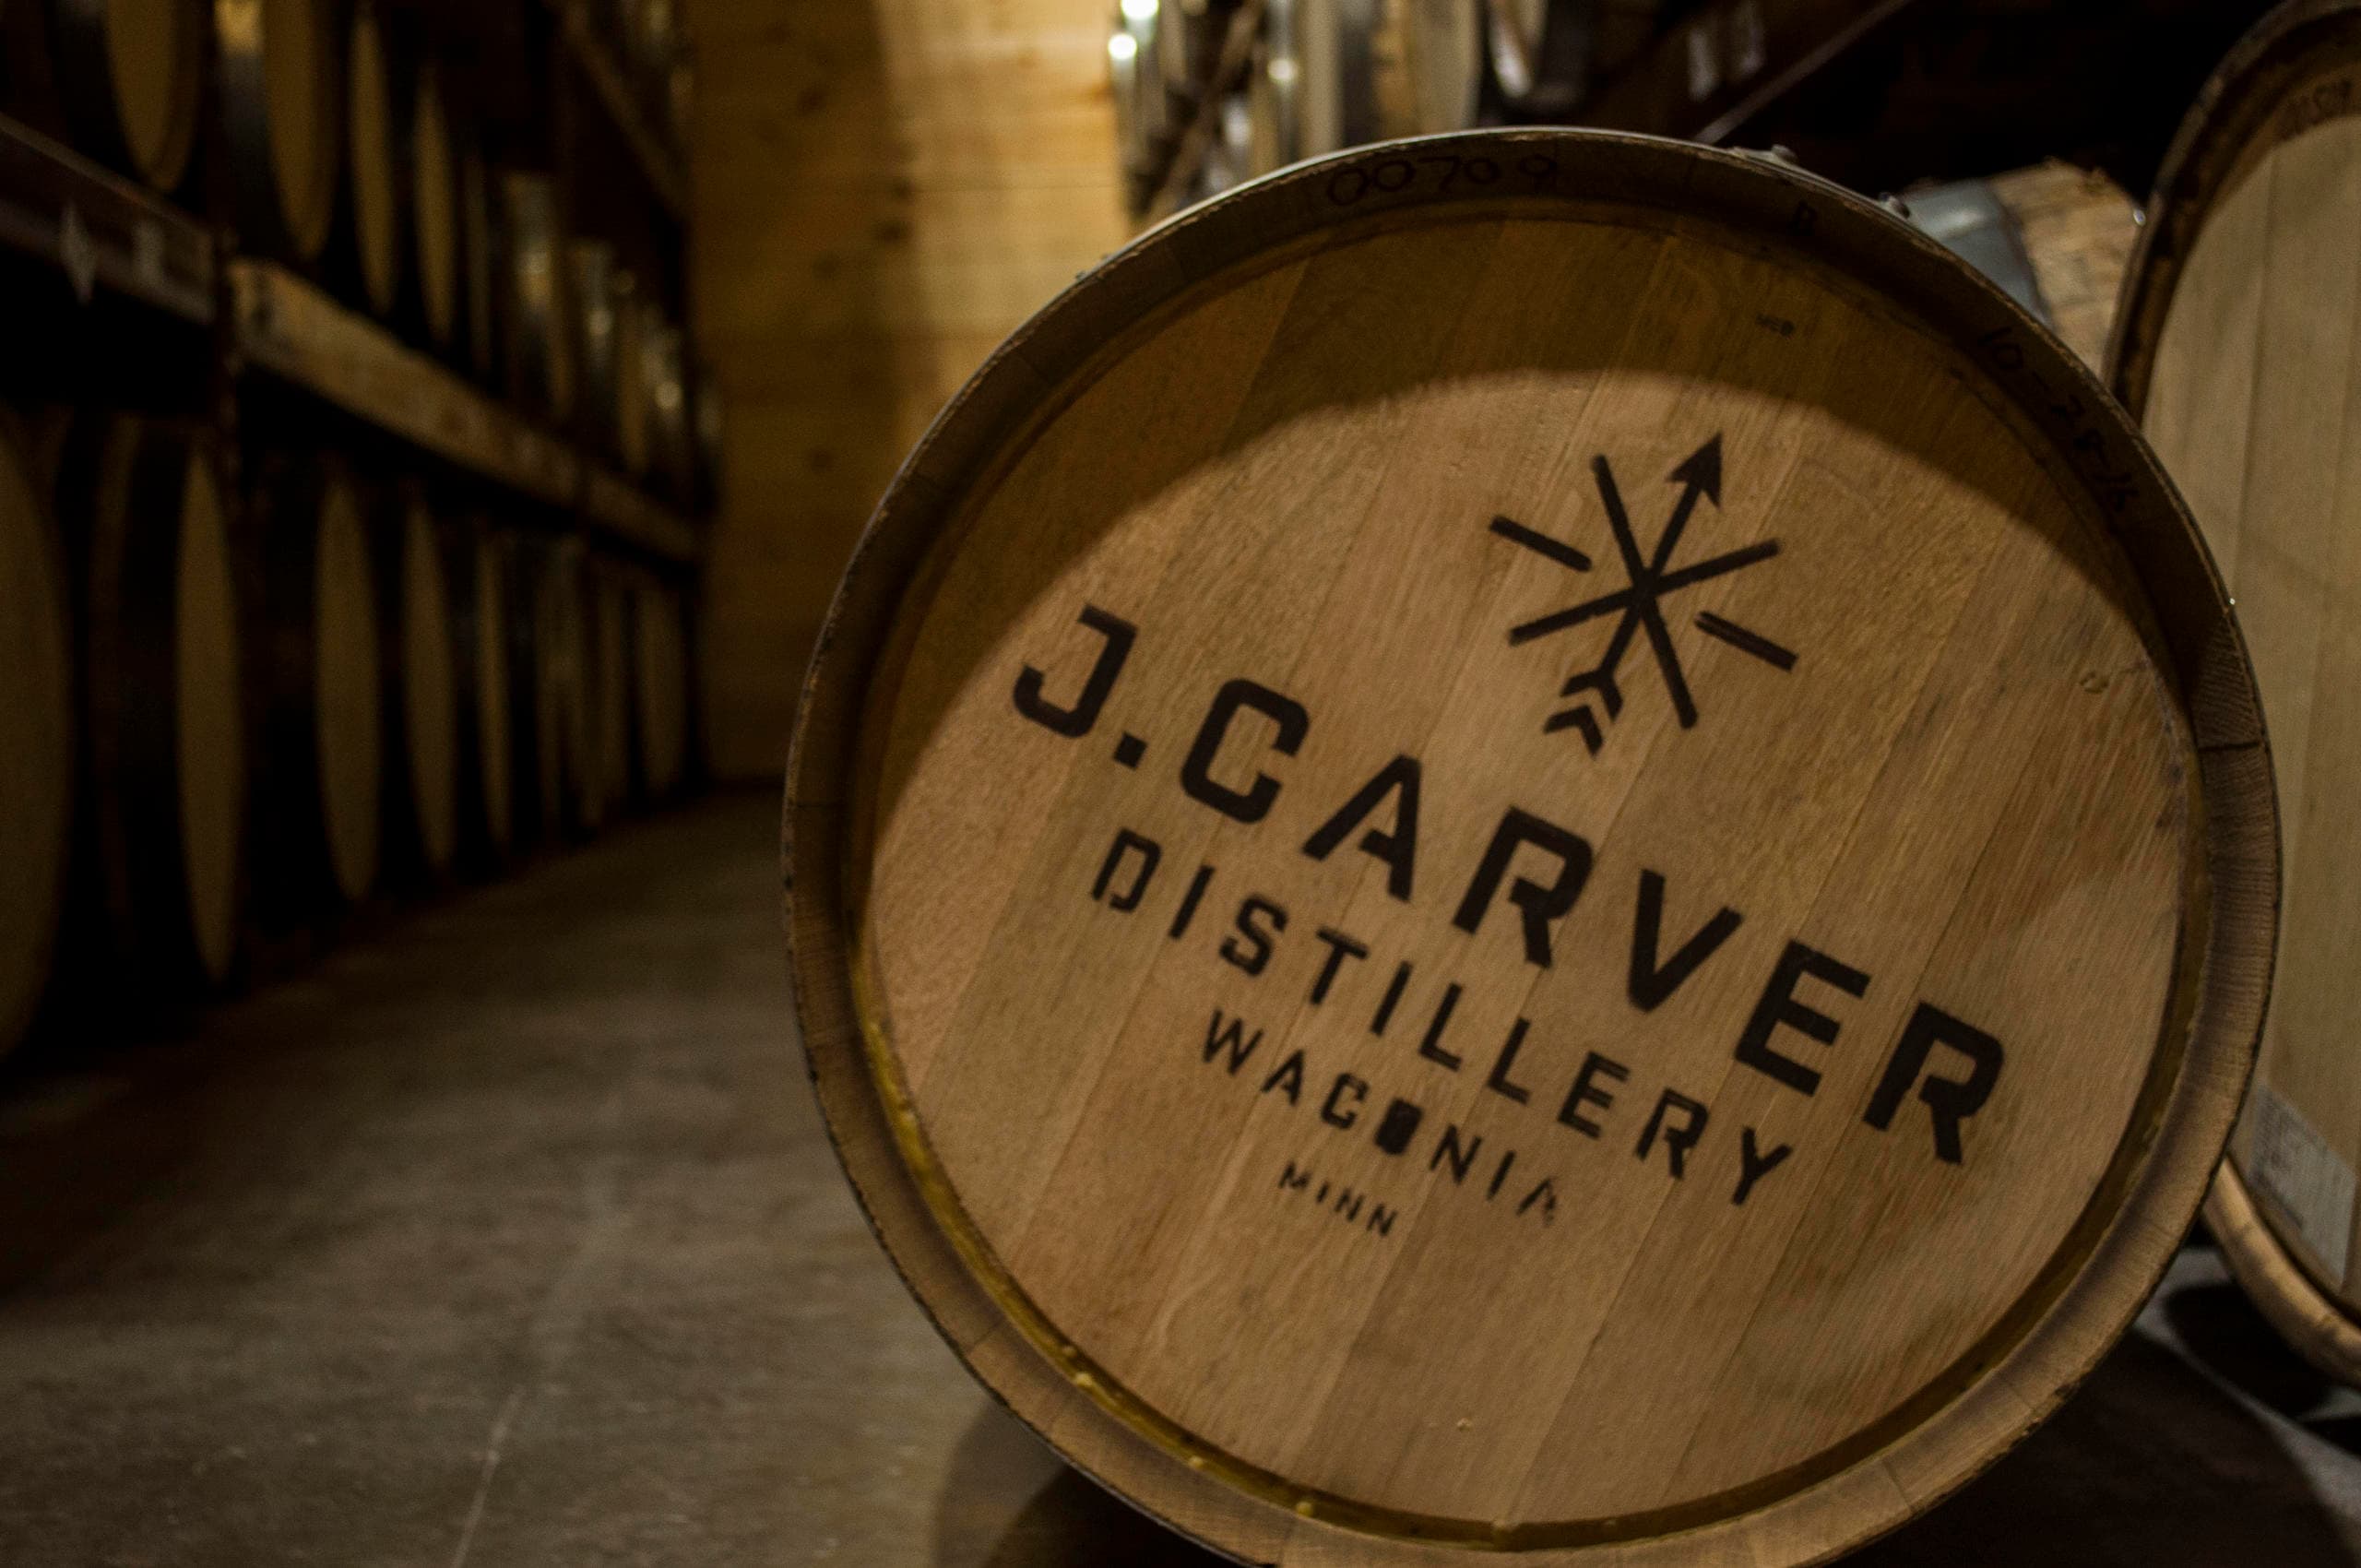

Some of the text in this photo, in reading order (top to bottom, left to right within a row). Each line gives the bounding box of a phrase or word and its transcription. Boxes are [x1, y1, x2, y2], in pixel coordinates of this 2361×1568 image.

[1092, 828, 1789, 1206] DISTILLERY
[1202, 1009, 1560, 1227] WACONIA
[1278, 1160, 1398, 1238] MINN
